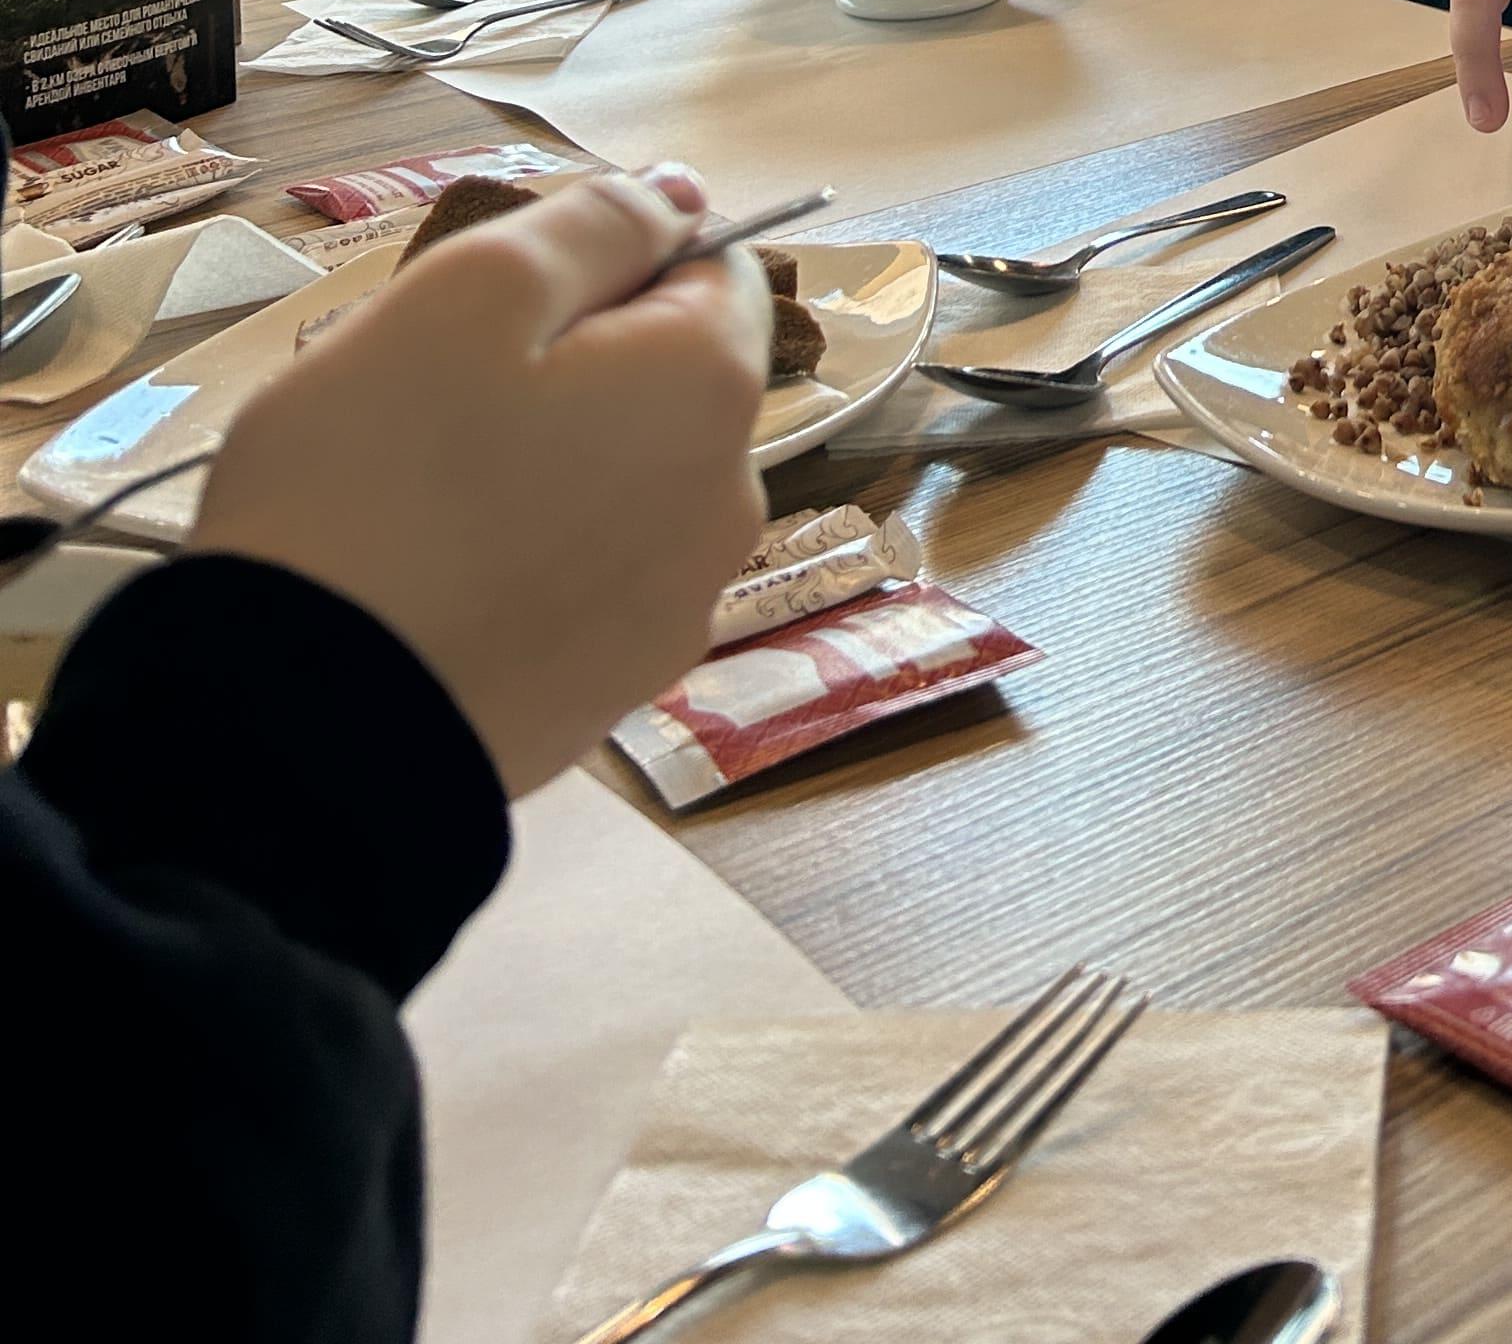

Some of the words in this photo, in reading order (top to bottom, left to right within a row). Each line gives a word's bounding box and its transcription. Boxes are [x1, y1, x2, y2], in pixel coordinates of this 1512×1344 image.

[24, 38, 78, 64] СВИДАНИЙ
[79, 34, 100, 51] ИЛИ
[101, 19, 152, 45] СЕМЕЙНОГО
[153, 8, 188, 30] ОТДЫХА
[30, 21, 89, 48] ИДЕАЛЬНОЕ
[90, 13, 120, 33] МЕСТО
[121, 7, 141, 26] ДЛЯ
[25, 83, 72, 110] АРЕНДОЙ
[73, 69, 127, 97] ИНВЕНТАРЯ
[61, 160, 121, 183] SUGAR
